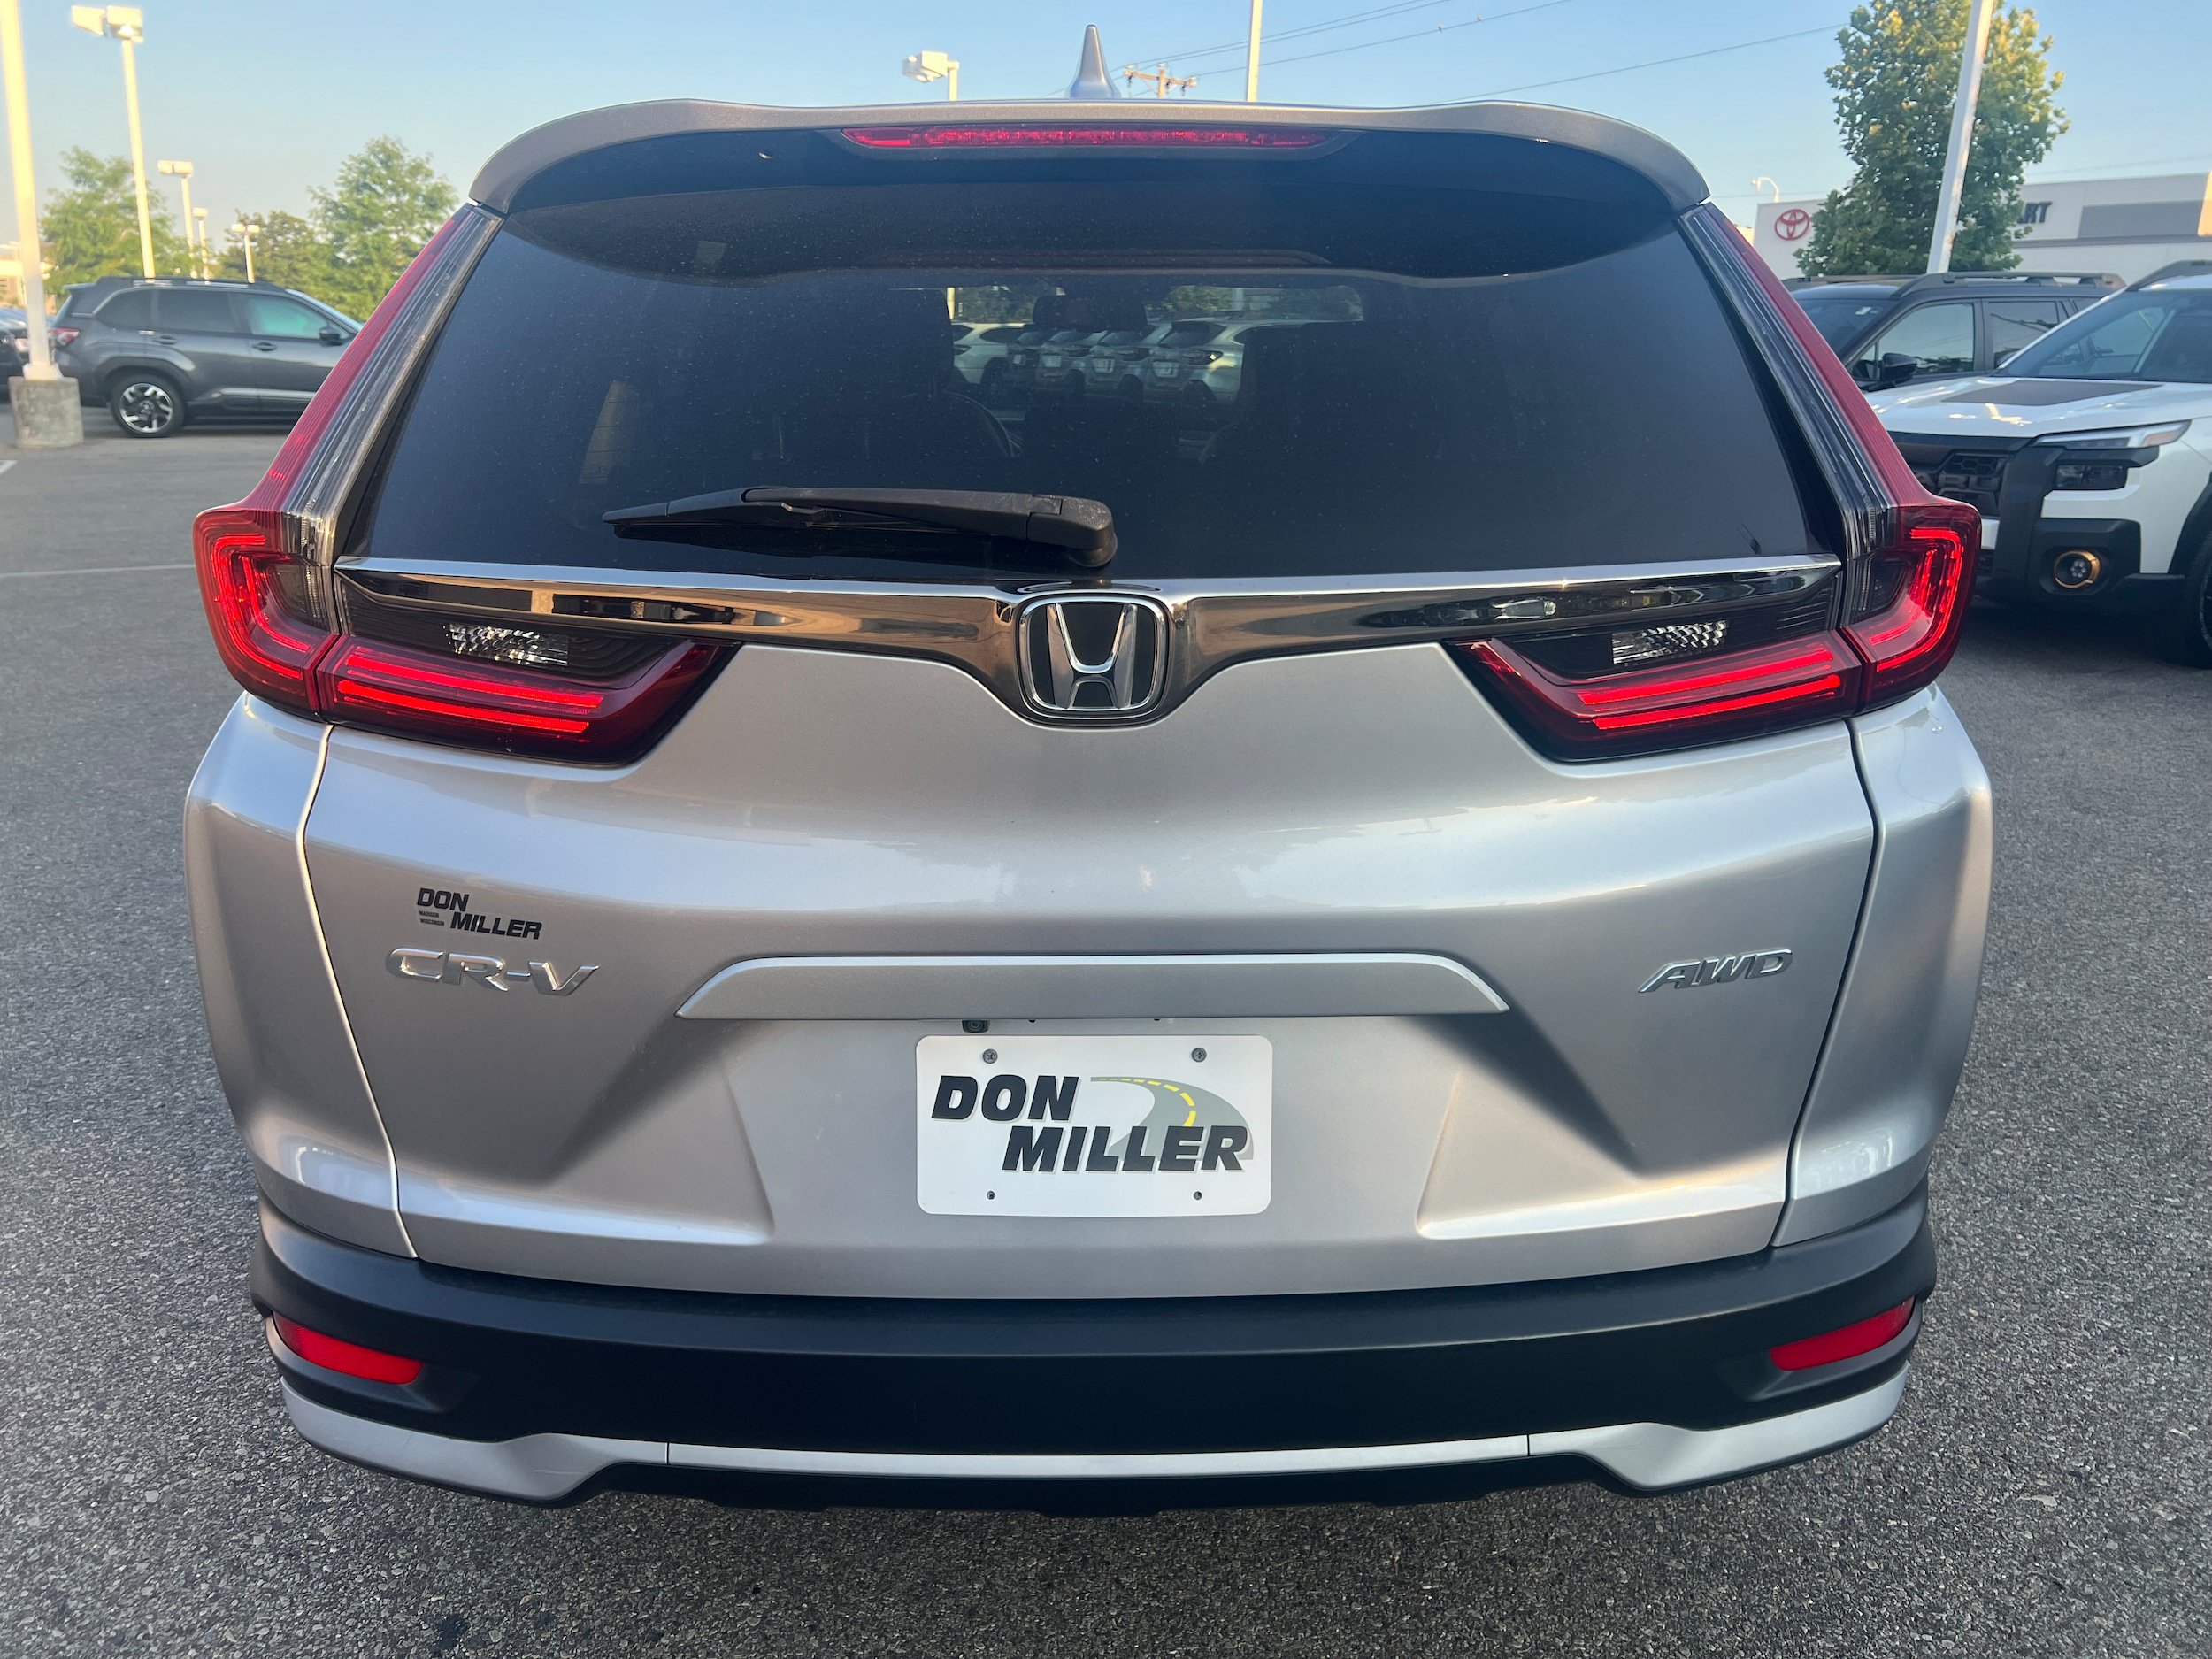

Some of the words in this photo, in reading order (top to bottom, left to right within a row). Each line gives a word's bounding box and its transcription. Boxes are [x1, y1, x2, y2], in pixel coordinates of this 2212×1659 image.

[417, 887, 470, 912] DON
[450, 912, 542, 940] MILLER
[386, 947, 600, 996] CR-V
[1637, 948, 1793, 993] AWD
[931, 1074, 1079, 1122] DON
[1002, 1125, 1248, 1172] MILLER
